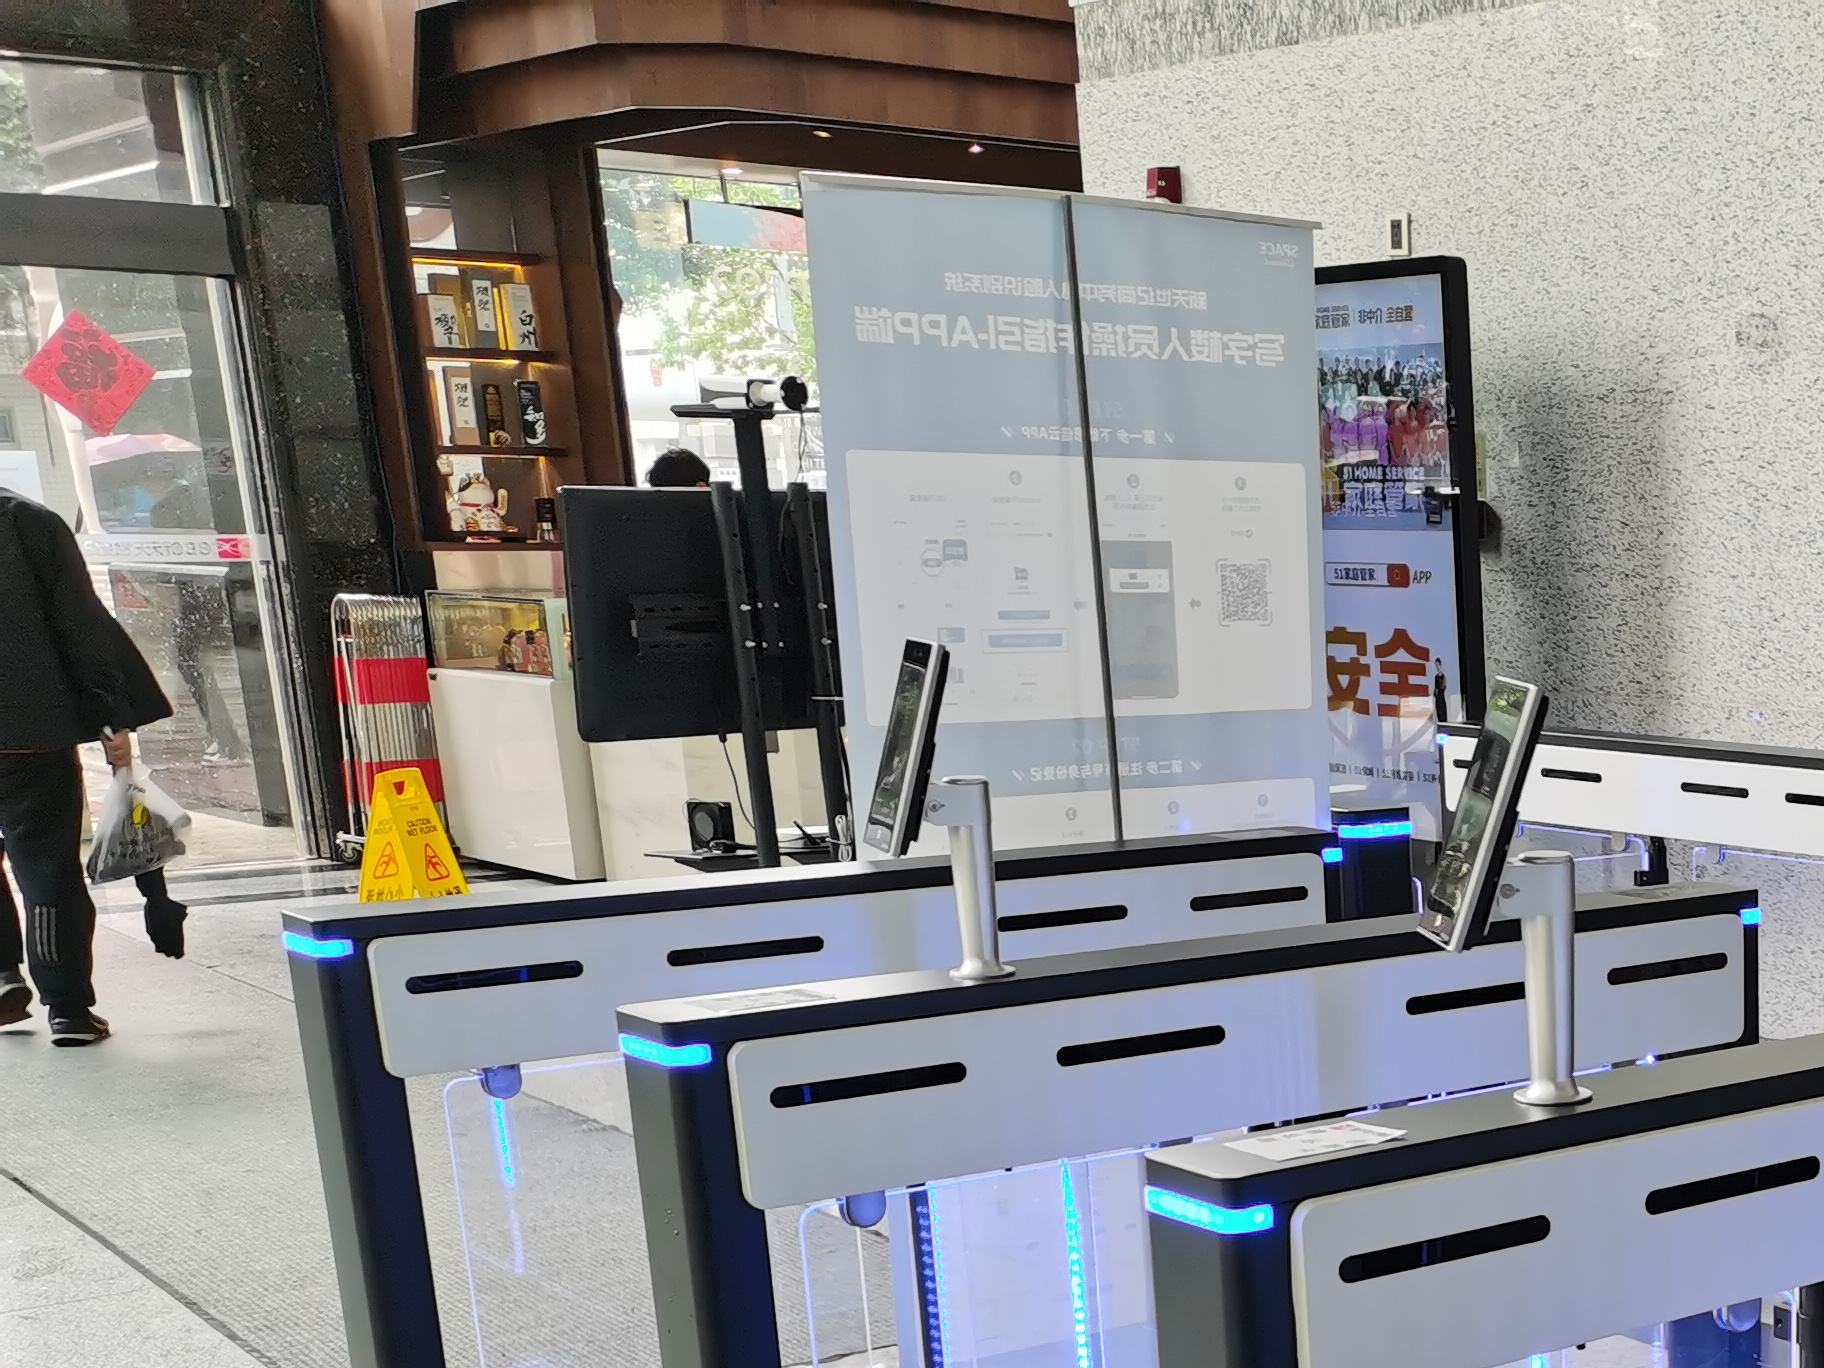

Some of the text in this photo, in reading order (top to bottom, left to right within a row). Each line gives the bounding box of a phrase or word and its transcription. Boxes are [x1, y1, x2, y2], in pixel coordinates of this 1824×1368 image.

[519, 309, 539, 348] 白州
[1354, 466, 1383, 480] HOME
[1412, 570, 1432, 585] APP
[1326, 626, 1432, 717] 安全
